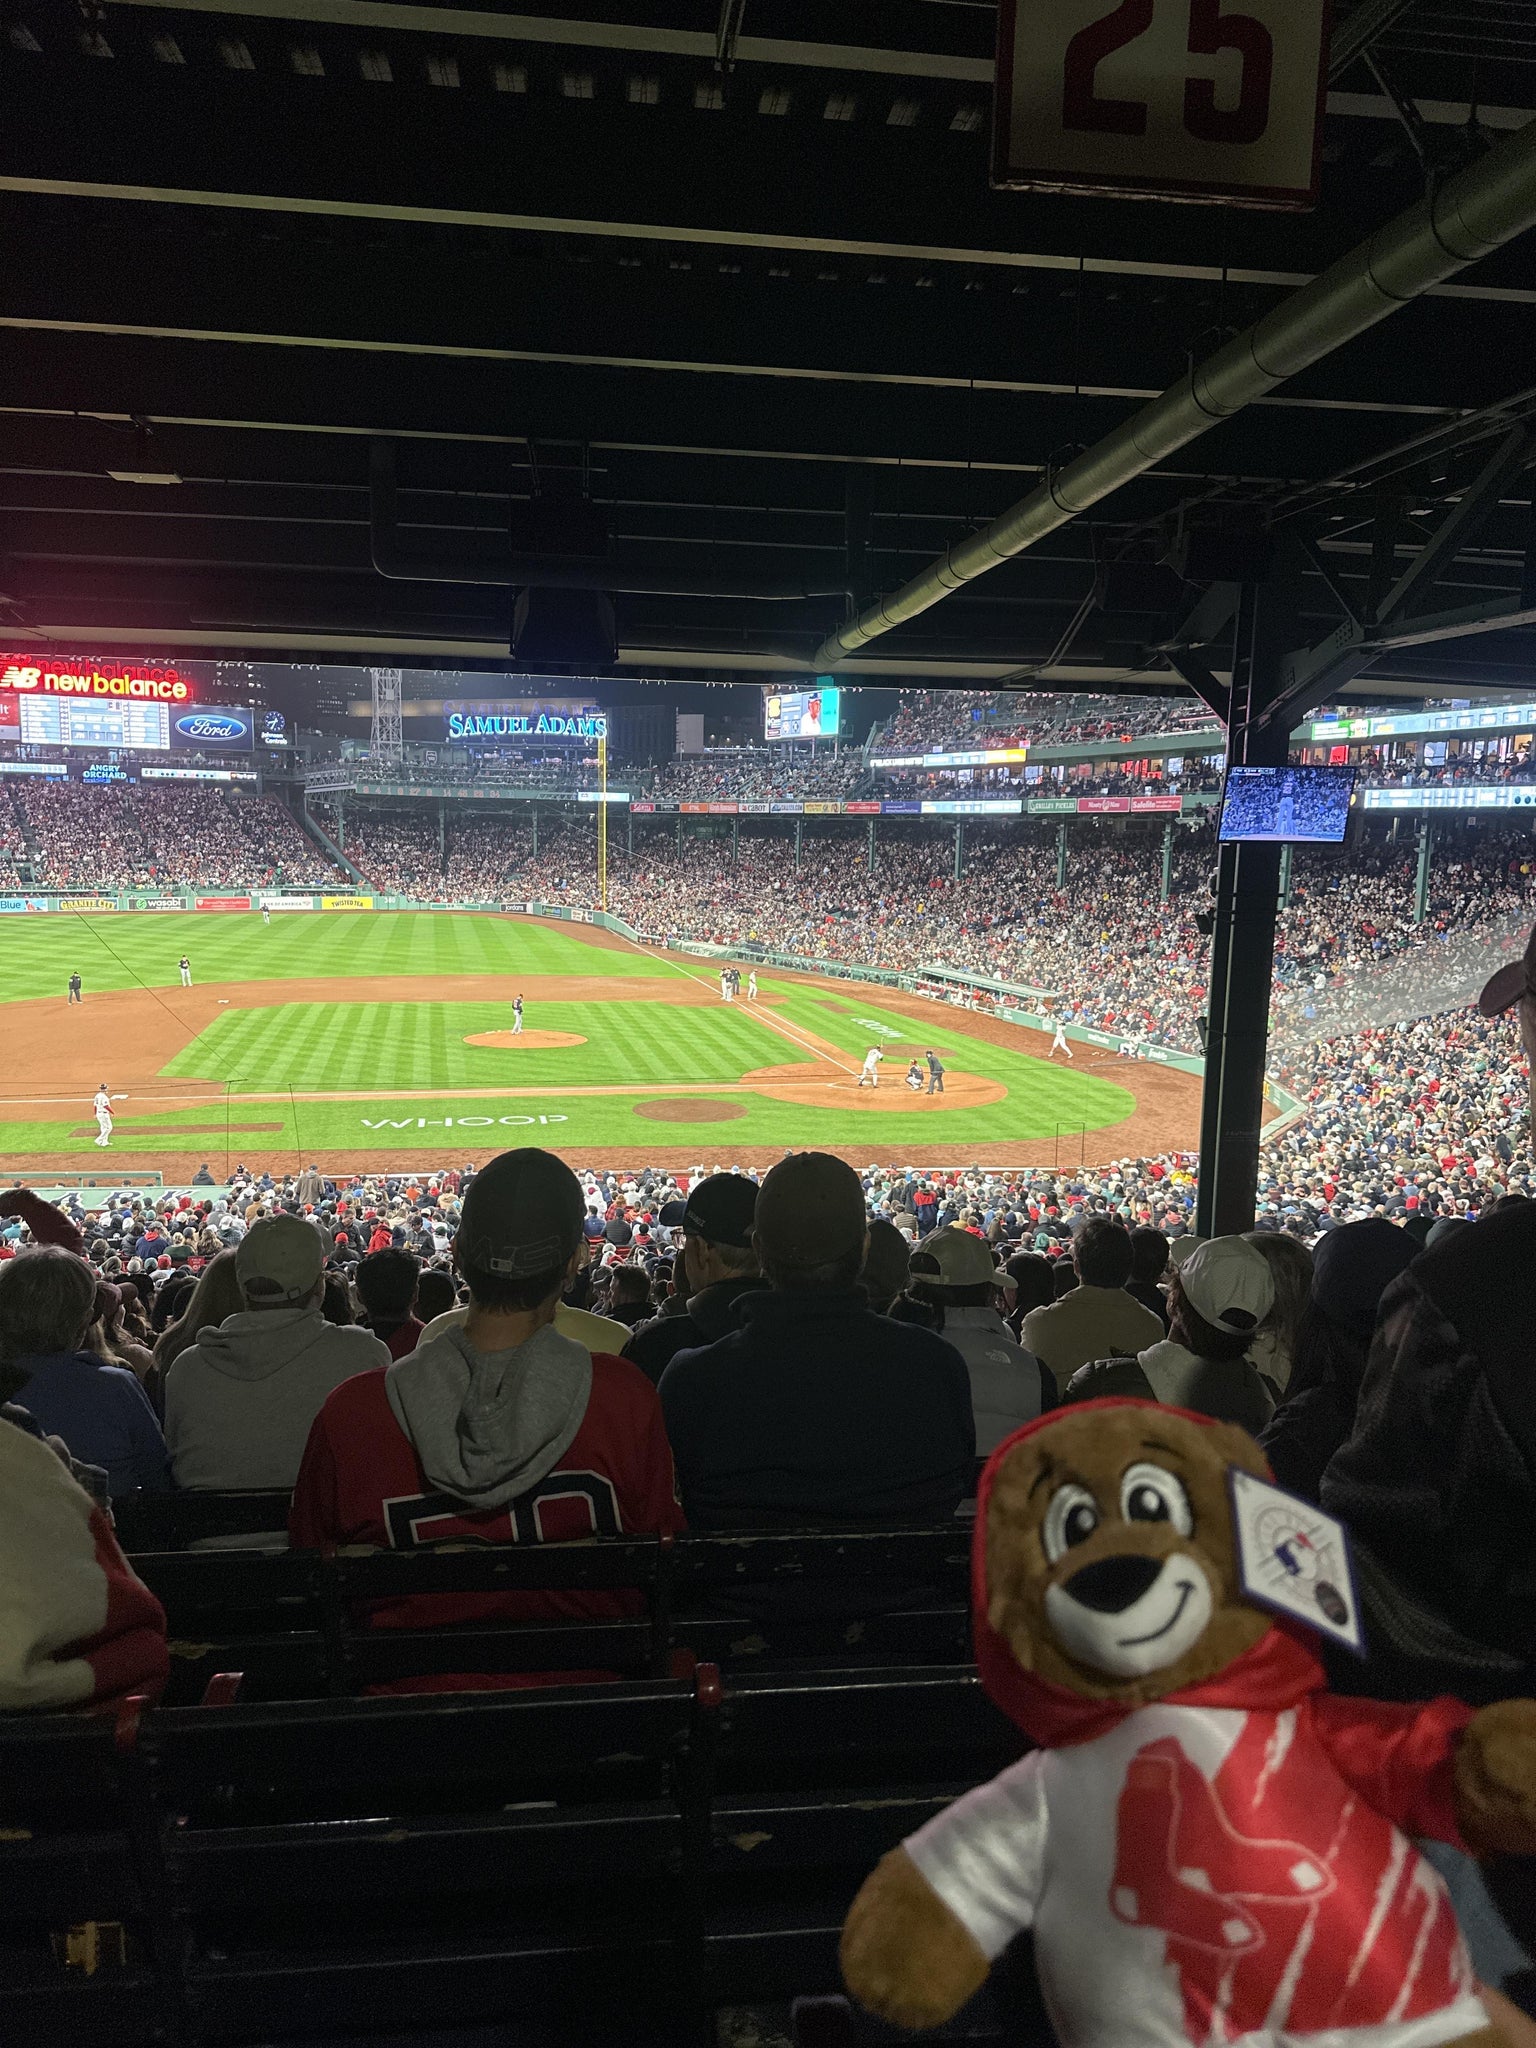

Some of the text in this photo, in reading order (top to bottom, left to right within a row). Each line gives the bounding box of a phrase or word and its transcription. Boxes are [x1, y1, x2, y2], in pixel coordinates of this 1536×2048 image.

[1062, 0, 1273, 144] 25
[44, 672, 188, 698] new balance
[190, 718, 233, 736] Ford
[449, 713, 607, 738] SAMUEL ADAMS
[82, 770, 127, 779] ORCHARD
[0, 901, 21, 909] Blue
[60, 898, 116, 910] GRANITE CITY
[147, 898, 181, 907] wasabi
[360, 1114, 569, 1129] WHOOP
